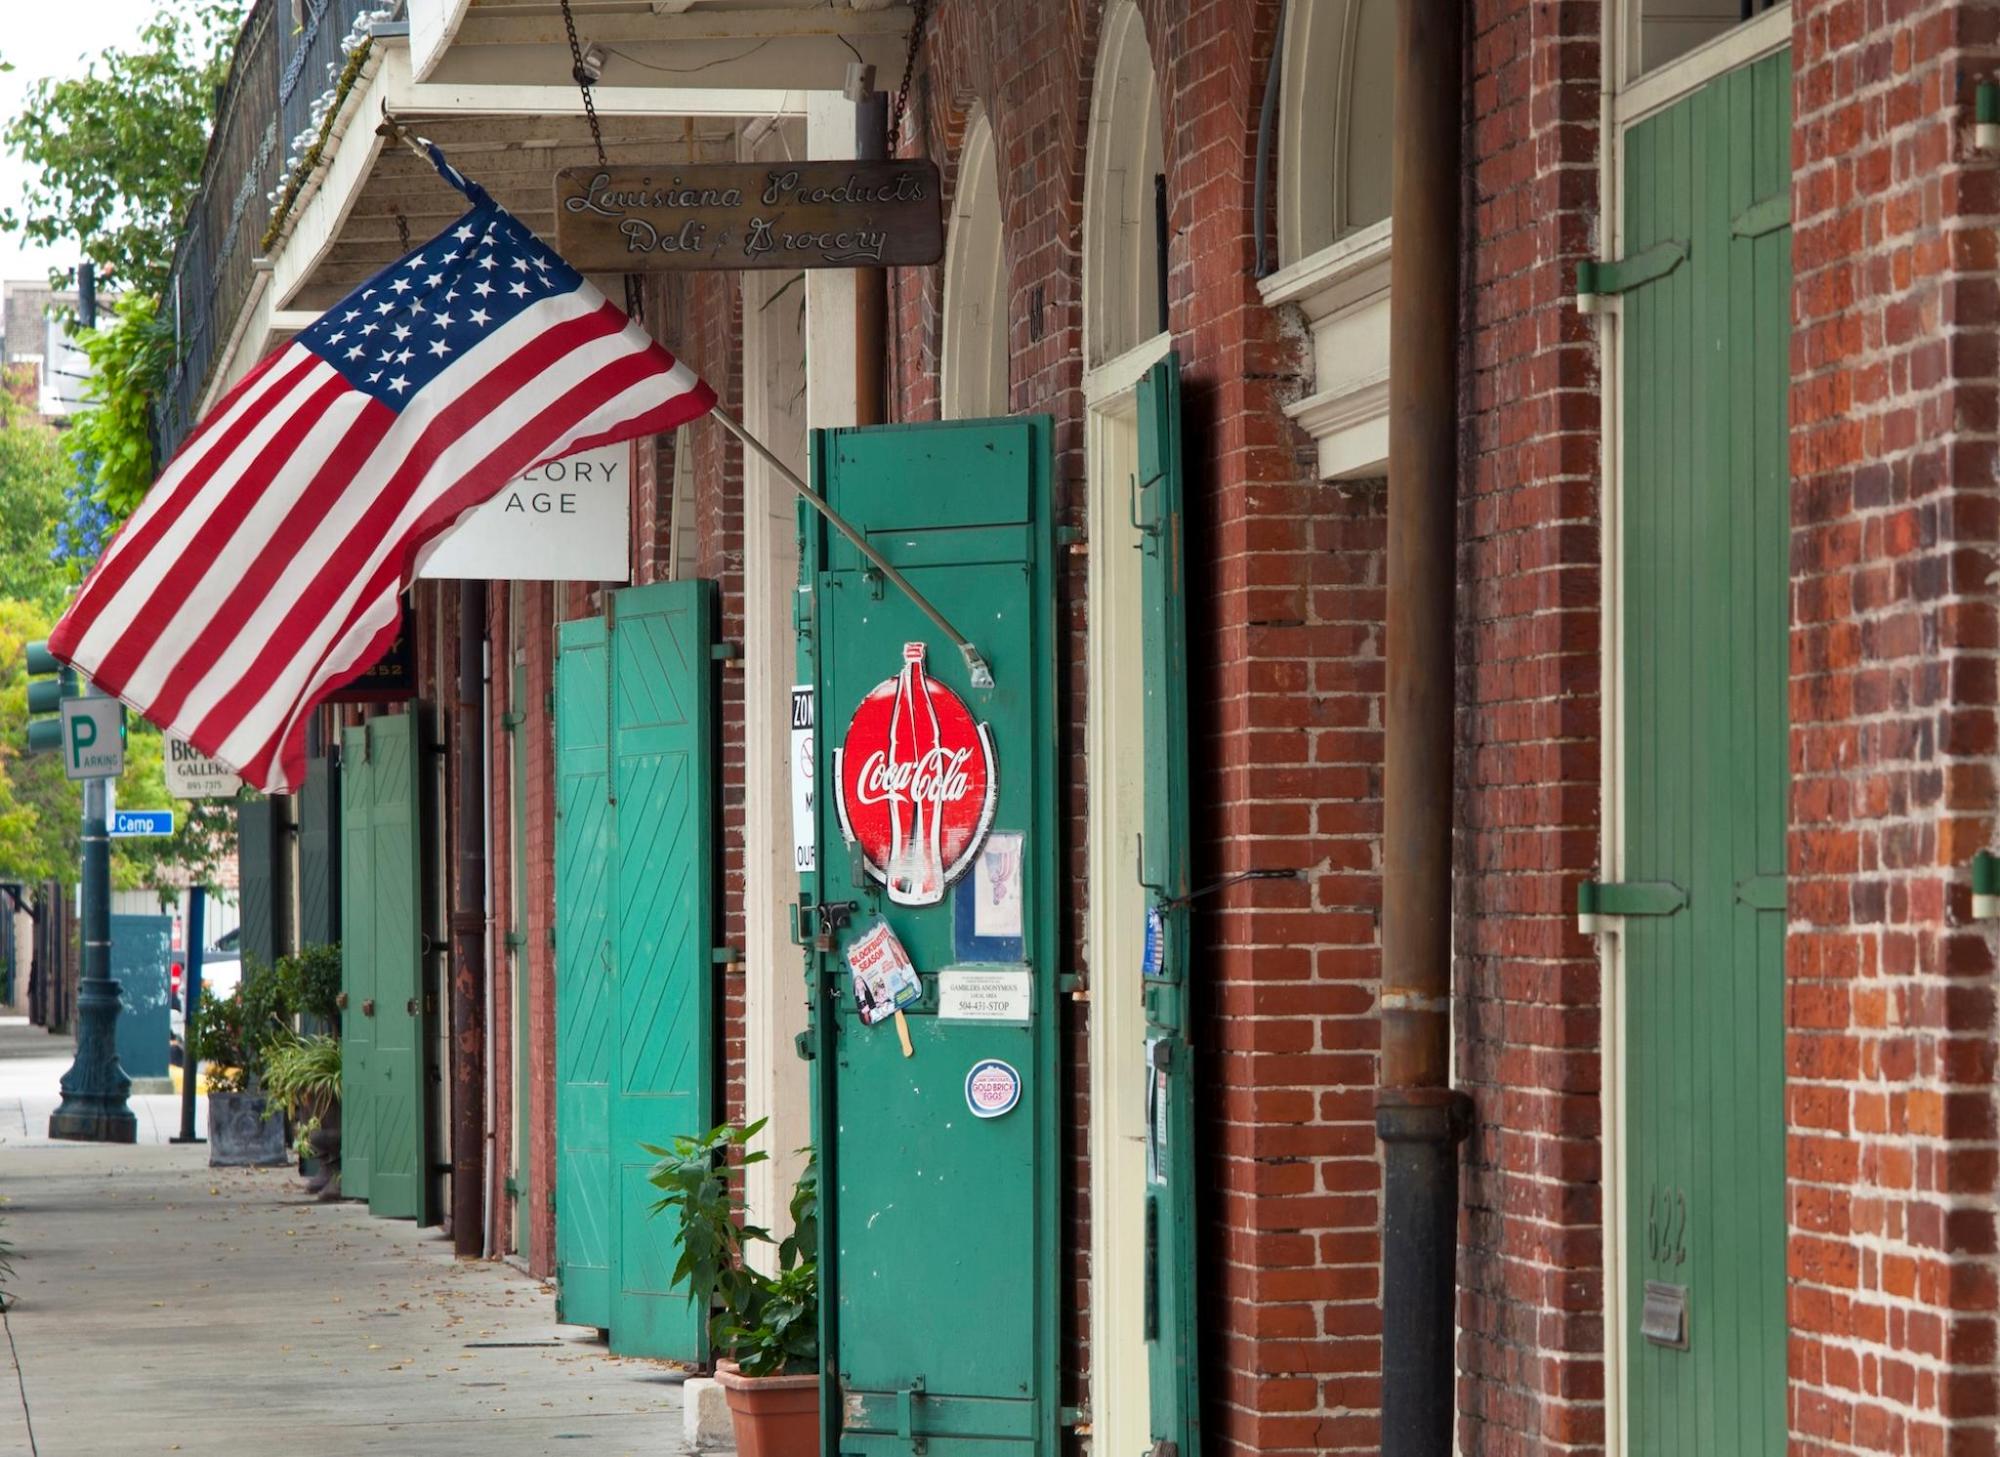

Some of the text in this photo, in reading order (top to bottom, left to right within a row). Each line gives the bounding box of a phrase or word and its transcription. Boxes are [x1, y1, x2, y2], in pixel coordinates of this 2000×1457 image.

[565, 170, 926, 216] Louisiana Products
[619, 218, 705, 253] Deli
[744, 212, 888, 261] Grocery
[118, 815, 155, 834] Camp
[858, 947, 885, 972] SEASON
[950, 984, 1018, 992] GAMBLERS ANONYMOUS
[973, 1083, 992, 1092] GOLD
[984, 1092, 1002, 1100] EGGS
